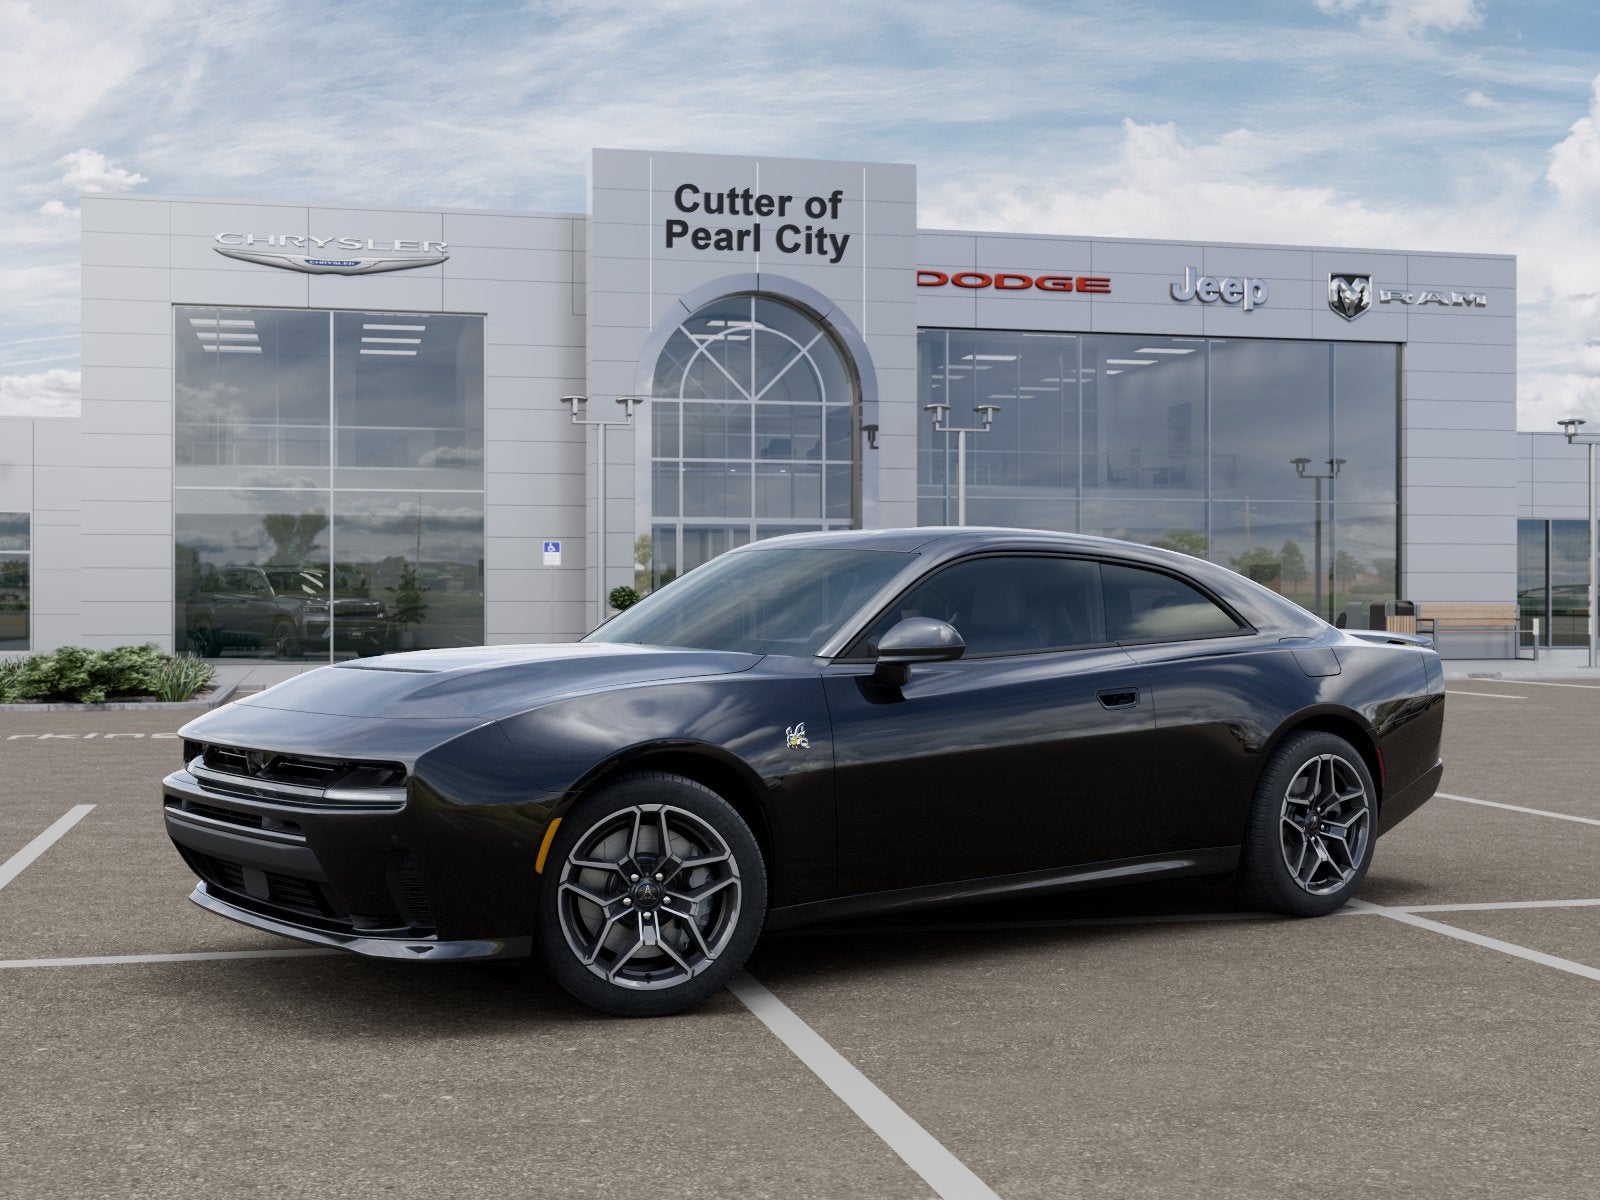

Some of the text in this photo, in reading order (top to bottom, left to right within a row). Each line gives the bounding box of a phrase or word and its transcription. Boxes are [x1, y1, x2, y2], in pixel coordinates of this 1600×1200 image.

[674, 183, 843, 219] Cutter of
[214, 232, 449, 253] CHRYSLER
[665, 219, 850, 264] Pearl City
[916, 270, 1111, 294] DODGE
[1170, 266, 1268, 311] Jeep
[1379, 289, 1487, 308] RAM
